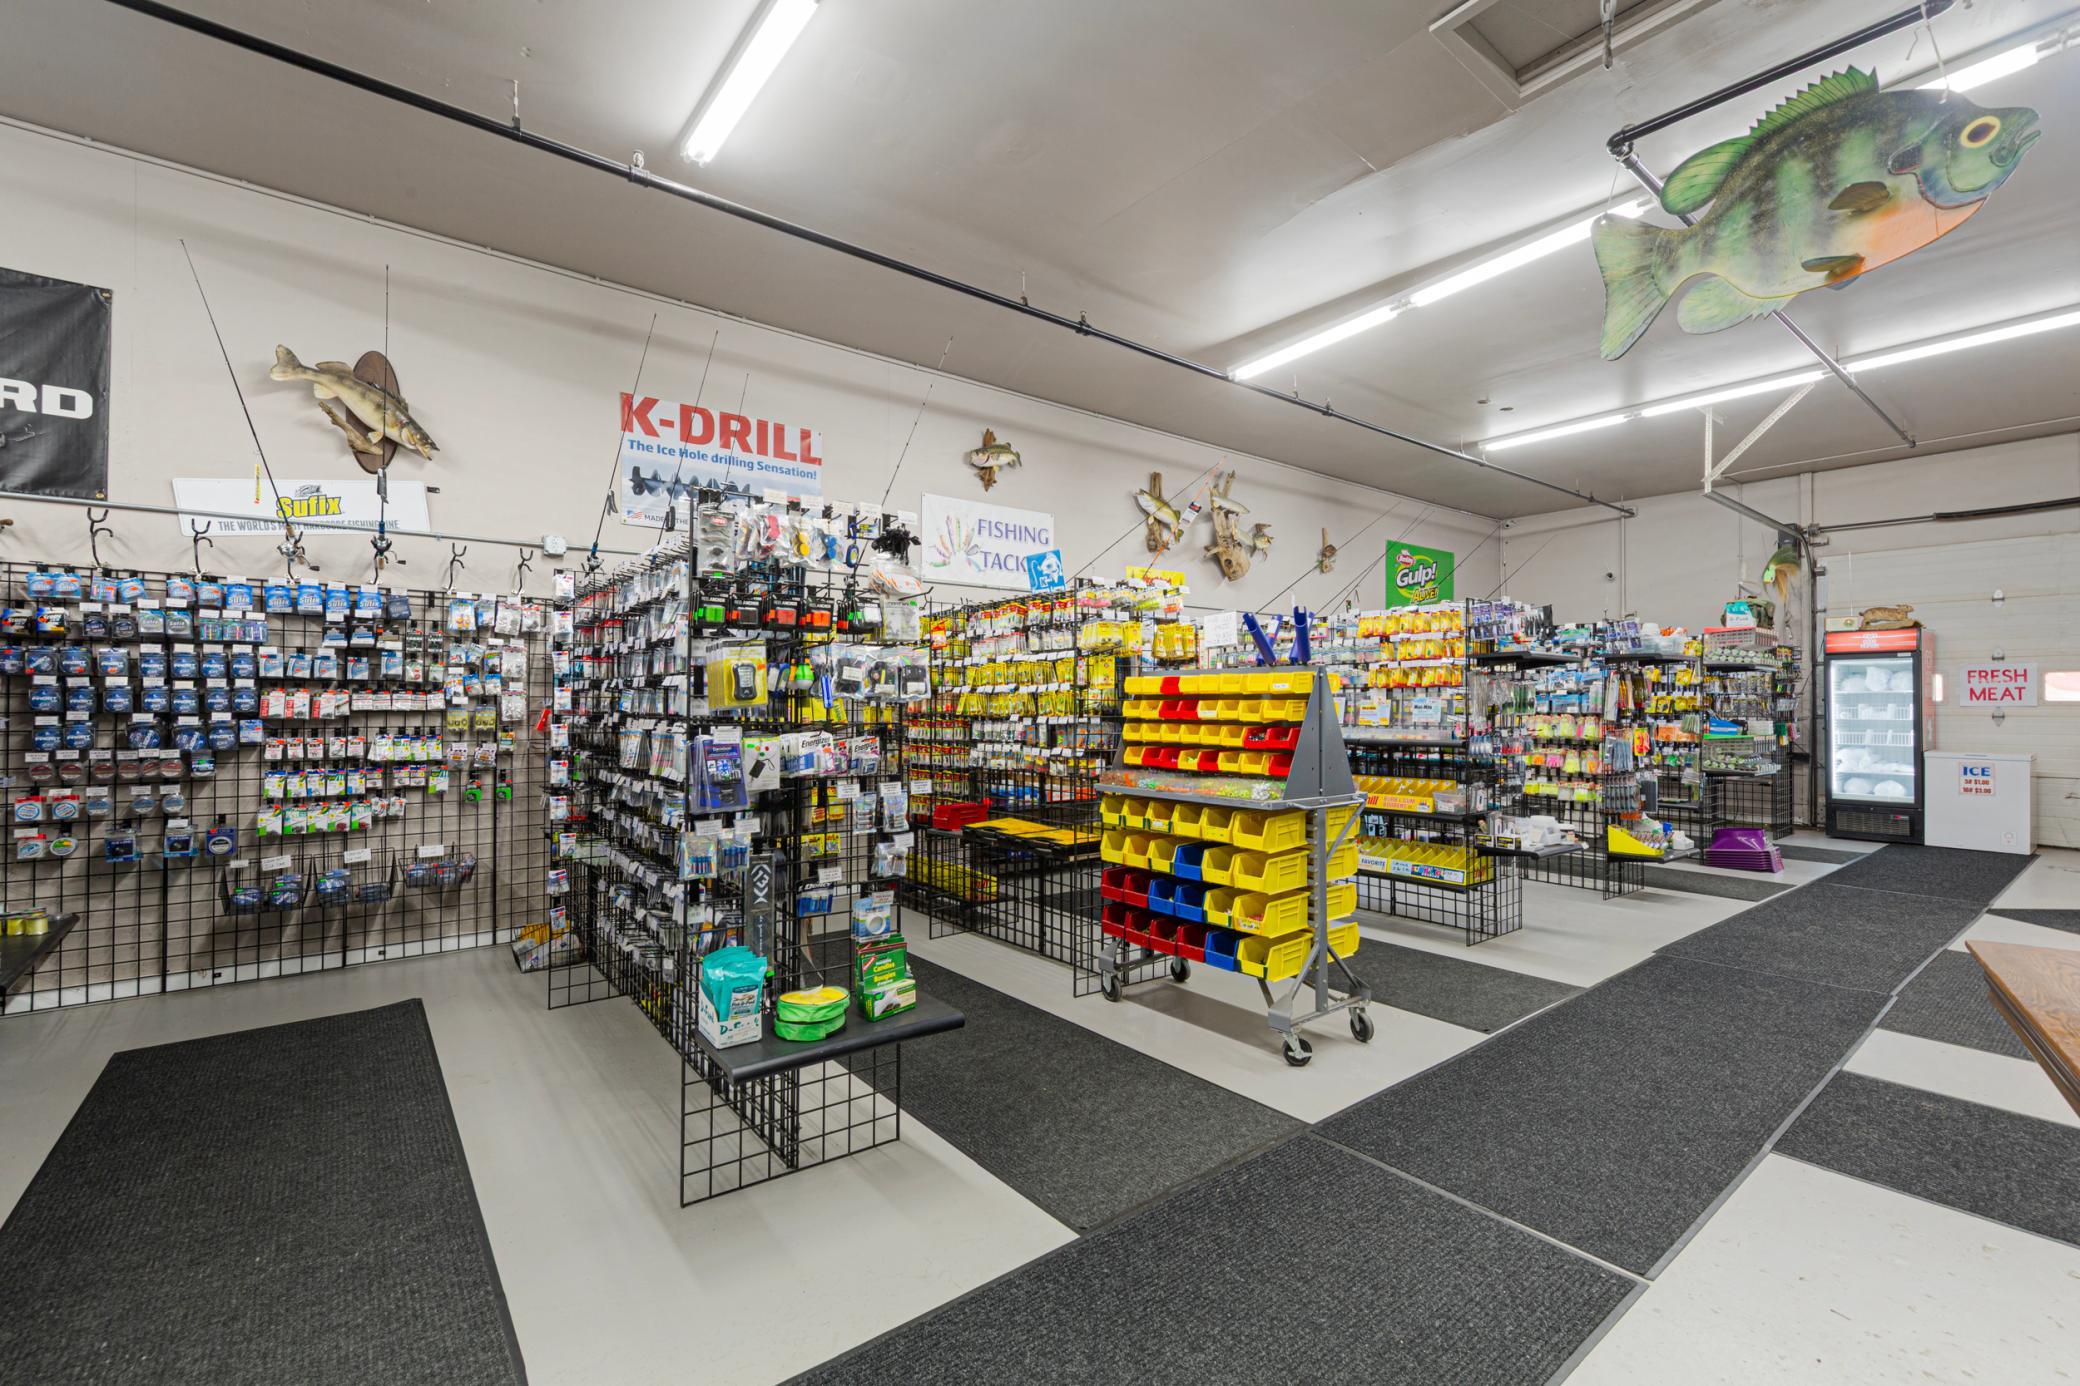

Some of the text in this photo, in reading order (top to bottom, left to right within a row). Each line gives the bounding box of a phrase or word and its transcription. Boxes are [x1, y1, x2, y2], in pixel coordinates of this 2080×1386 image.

[620, 392, 823, 466] K-DRILL
[627, 439, 818, 480] The Ice Hole drilling Sensation!
[276, 494, 343, 518] Sufix
[218, 521, 236, 531] THE
[977, 518, 1049, 545] FISHING
[1396, 562, 1437, 587] Gulp!
[1967, 668, 2028, 684] FRESH
[1969, 686, 2026, 701] MEAT
[1963, 766, 1991, 777] ICE
